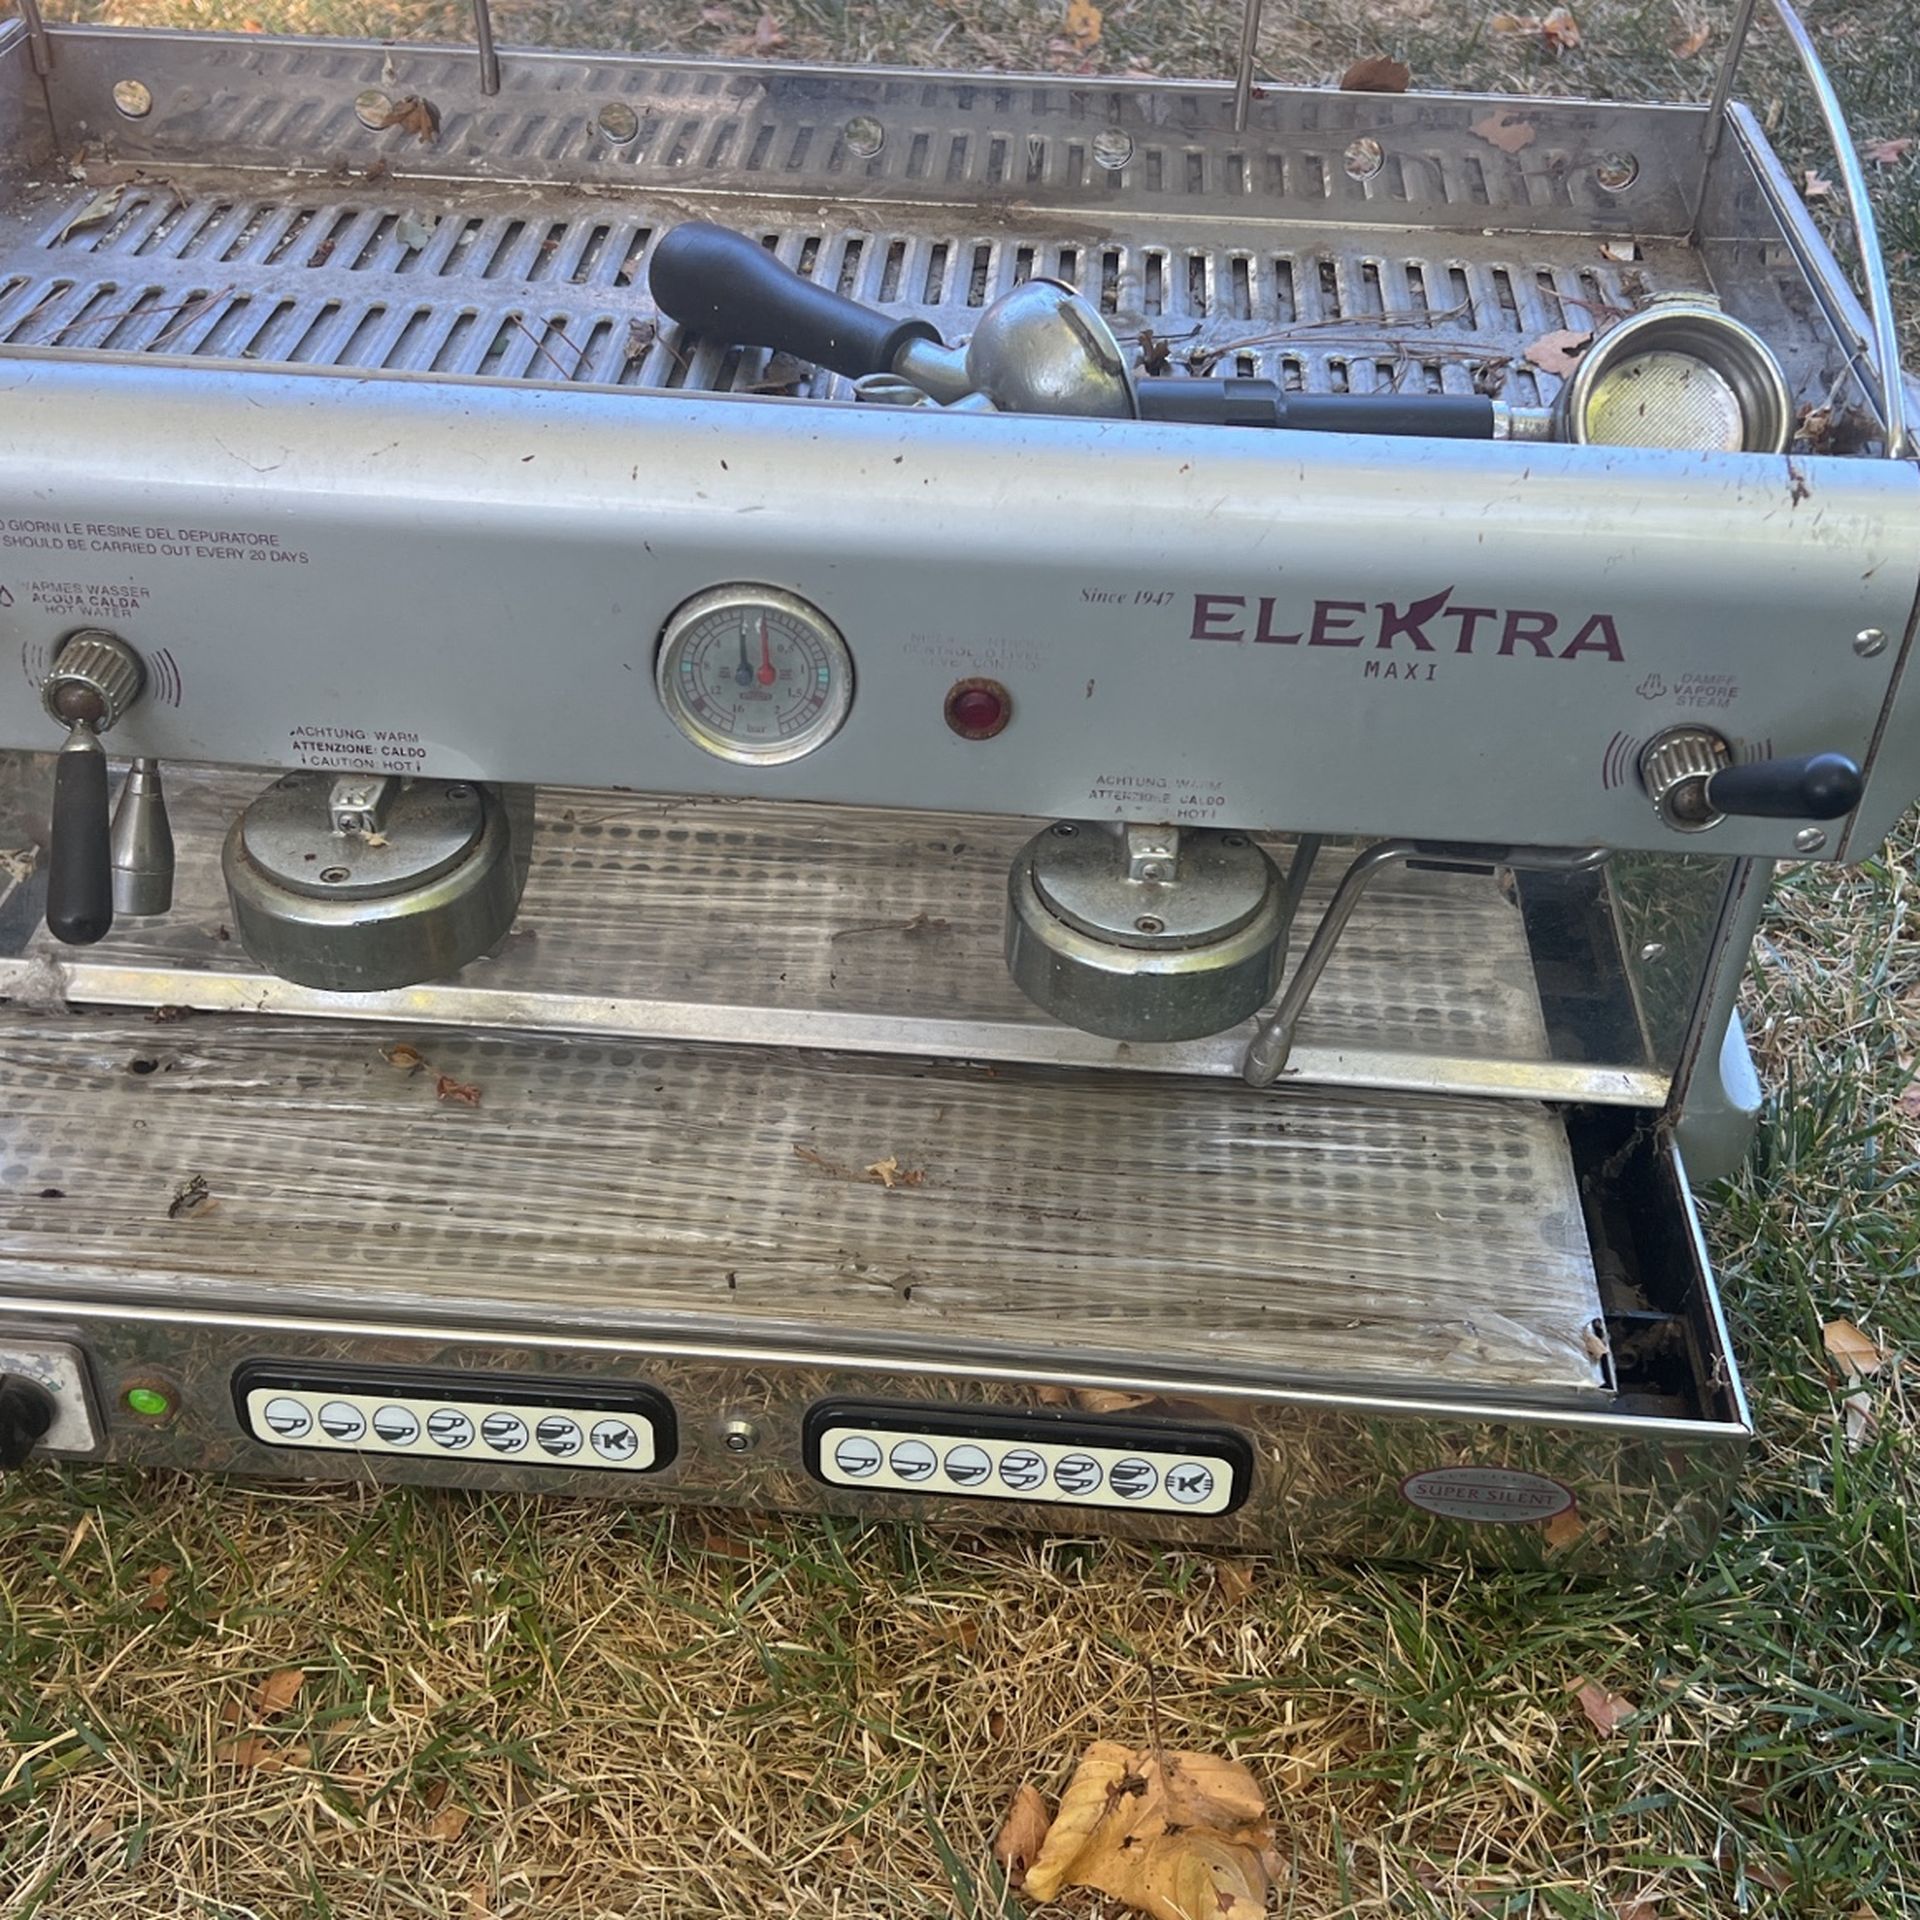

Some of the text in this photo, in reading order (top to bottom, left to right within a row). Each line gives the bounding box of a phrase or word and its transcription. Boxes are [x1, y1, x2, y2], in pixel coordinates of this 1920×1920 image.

[9, 520, 61, 533] GIORNI
[65, 523, 83, 535] LE
[87, 524, 142, 538] RESINE
[145, 527, 175, 541] DEL
[179, 530, 280, 546] DEPURATORE
[3, 535, 309, 564] SHOULD BE CARRIED OUT EVERY 20 DAYS
[86, 584, 150, 598] WASSER
[1081, 587, 1176, 606] Since 1947
[89, 595, 140, 609] CALDA
[45, 605, 132, 619] HOT WATER
[1189, 585, 1625, 662] ELEKTRA
[1364, 660, 1438, 682] MAXI
[1673, 684, 1740, 699] VAPORE
[1676, 696, 1731, 708] STEAM
[774, 705, 781, 715] 2
[374, 731, 419, 743] WARM
[381, 746, 426, 758] CALDO
[1088, 789, 1225, 807] ATTENZIOE CADO
[1415, 1483, 1558, 1506] SUPER SILENT
